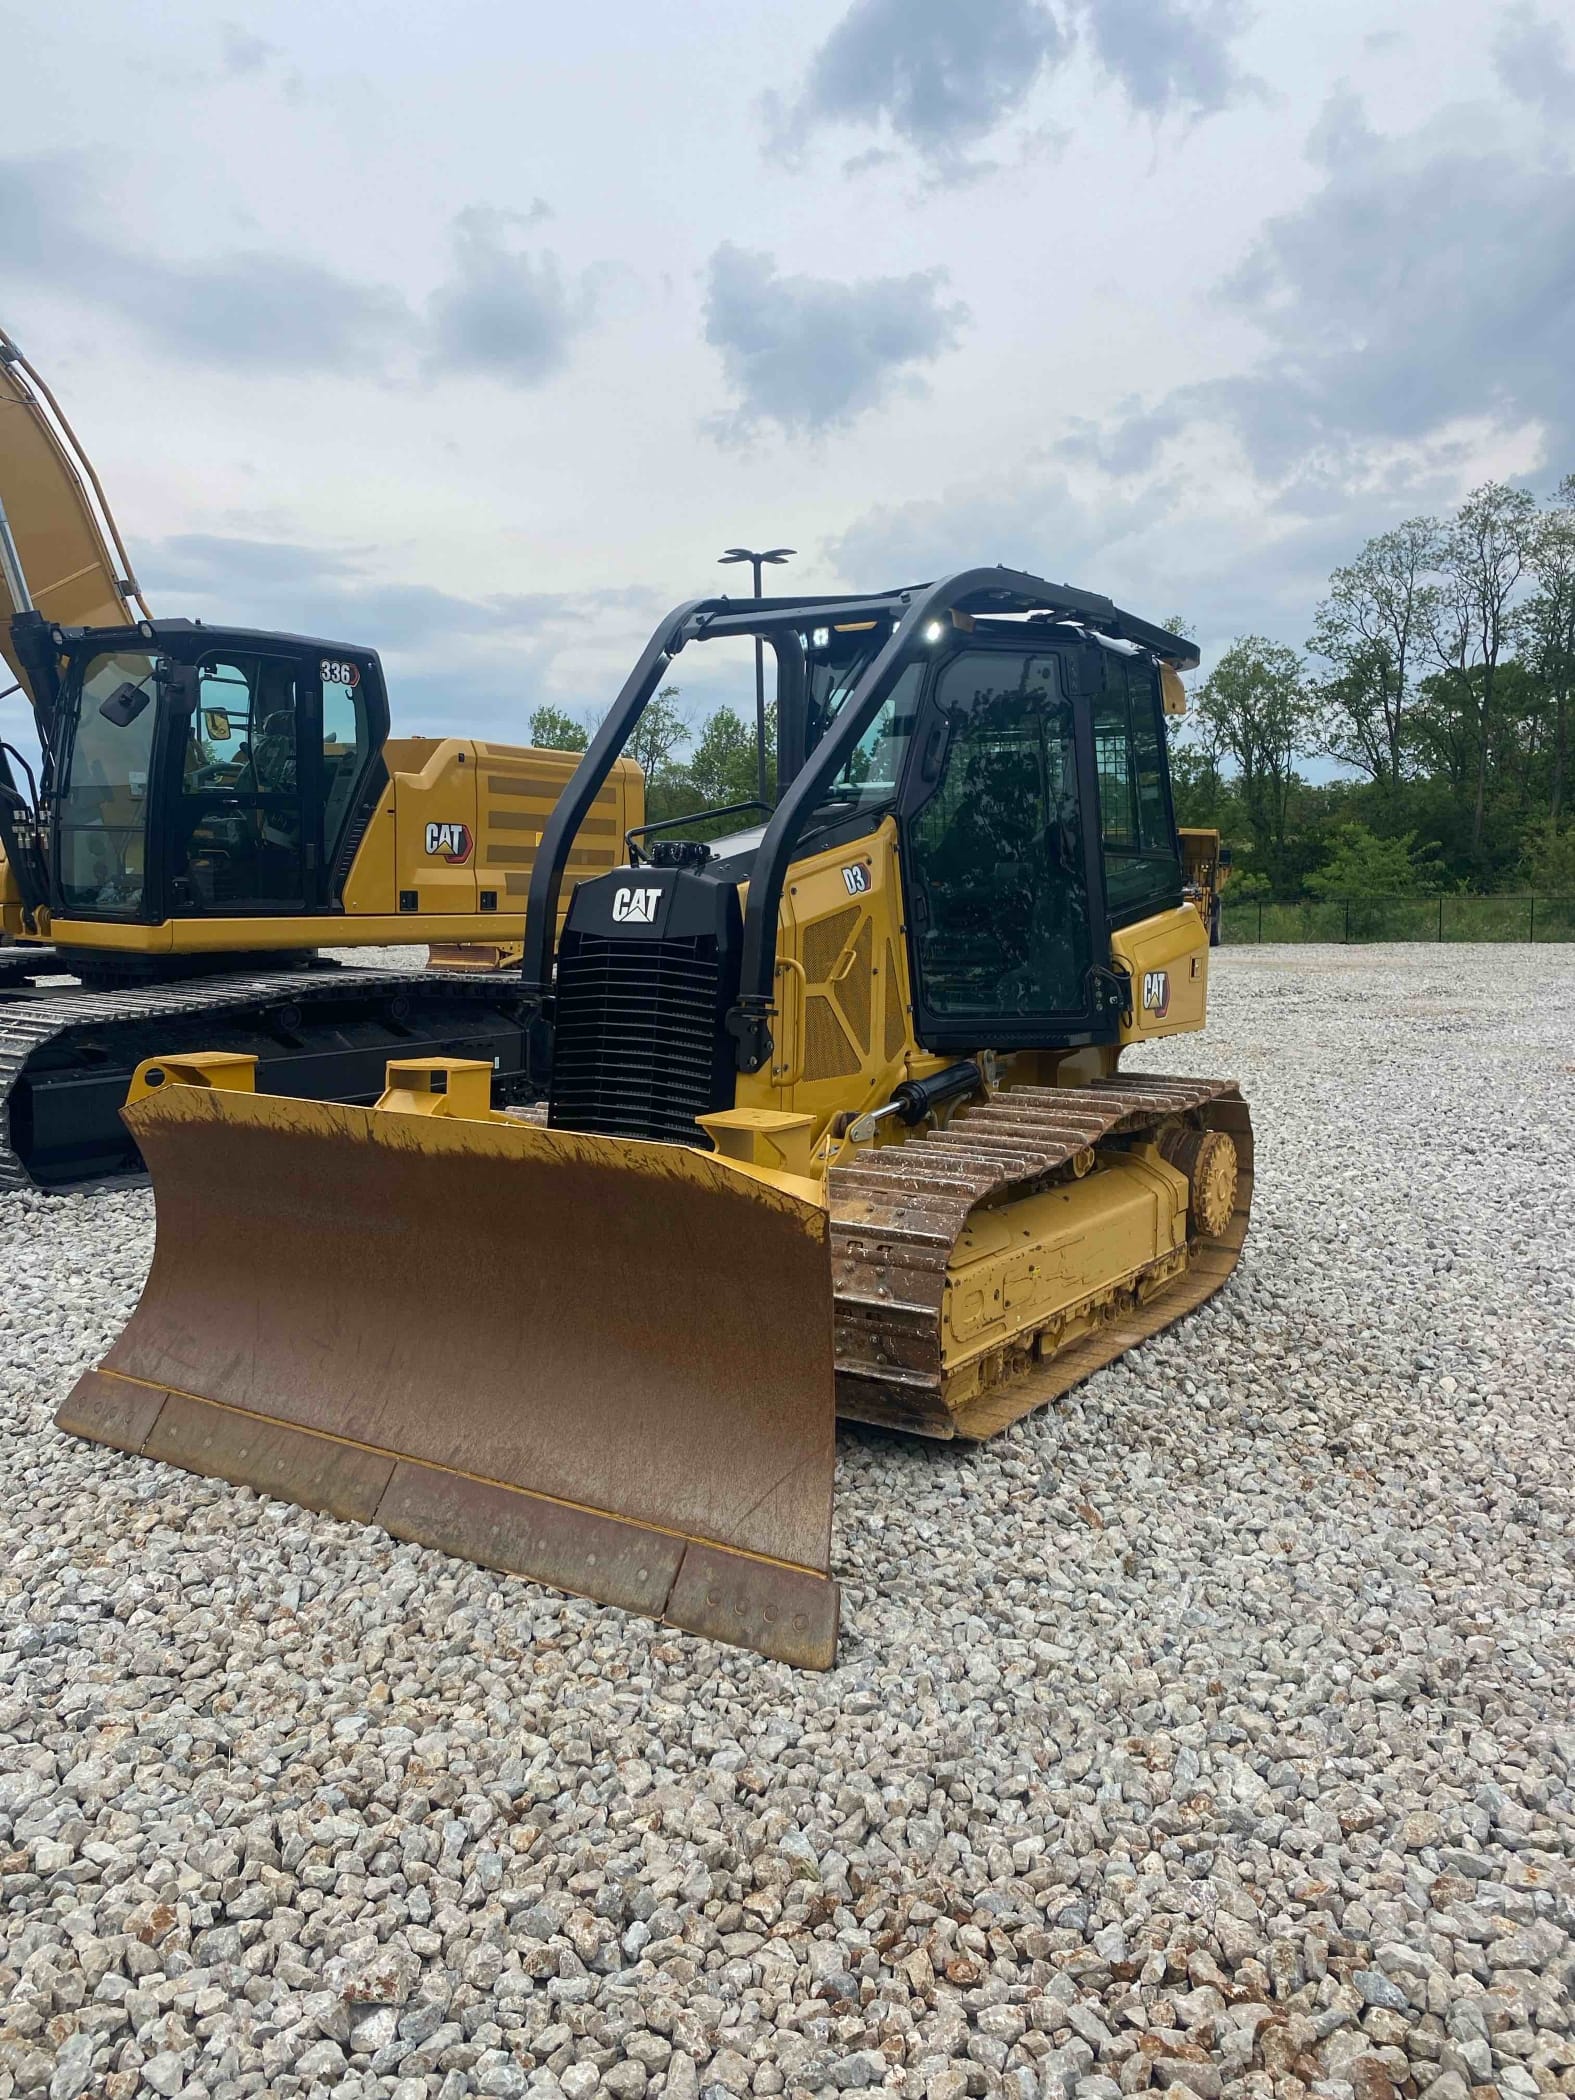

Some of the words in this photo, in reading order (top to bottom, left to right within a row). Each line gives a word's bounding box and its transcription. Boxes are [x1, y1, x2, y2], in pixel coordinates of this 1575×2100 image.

[321, 660, 350, 684] 336
[426, 823, 463, 855] CAT
[842, 865, 866, 895] D3
[612, 887, 663, 923] CAT
[1143, 973, 1166, 1009] CAT
